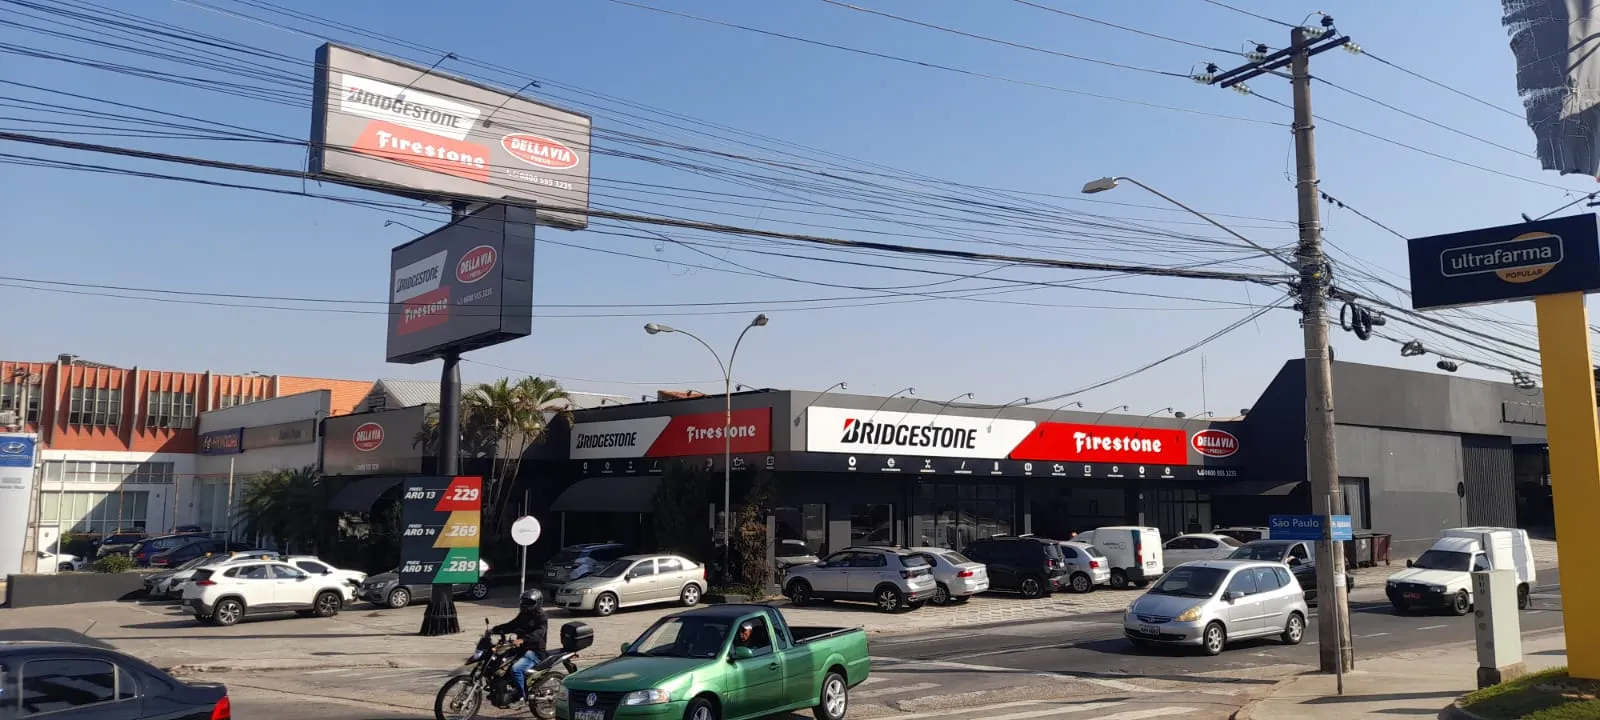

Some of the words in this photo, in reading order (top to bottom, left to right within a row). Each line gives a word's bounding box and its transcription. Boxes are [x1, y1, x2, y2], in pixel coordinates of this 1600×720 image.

[346, 87, 461, 129] BRIDGESTONE
[376, 130, 485, 168] Firestone
[1451, 246, 1552, 270] ultrafarma
[396, 265, 439, 293] BRIDGESTONE
[1505, 269, 1543, 279] POPULAR
[405, 298, 448, 325] Firestone
[576, 432, 638, 449] BRIDGESTONE
[840, 417, 978, 449] BRIDGESTONE
[1073, 431, 1162, 453] Firestone
[404, 492, 424, 500] ARO
[426, 492, 436, 500] 13
[453, 489, 479, 501] 229
[403, 528, 423, 537] ARO
[425, 528, 435, 536] 14
[450, 525, 477, 537] 269
[1272, 517, 1290, 528] São
[1292, 518, 1320, 528] Paulo
[402, 565, 422, 573] ARO
[423, 564, 434, 572] 15
[448, 560, 476, 572] 289
